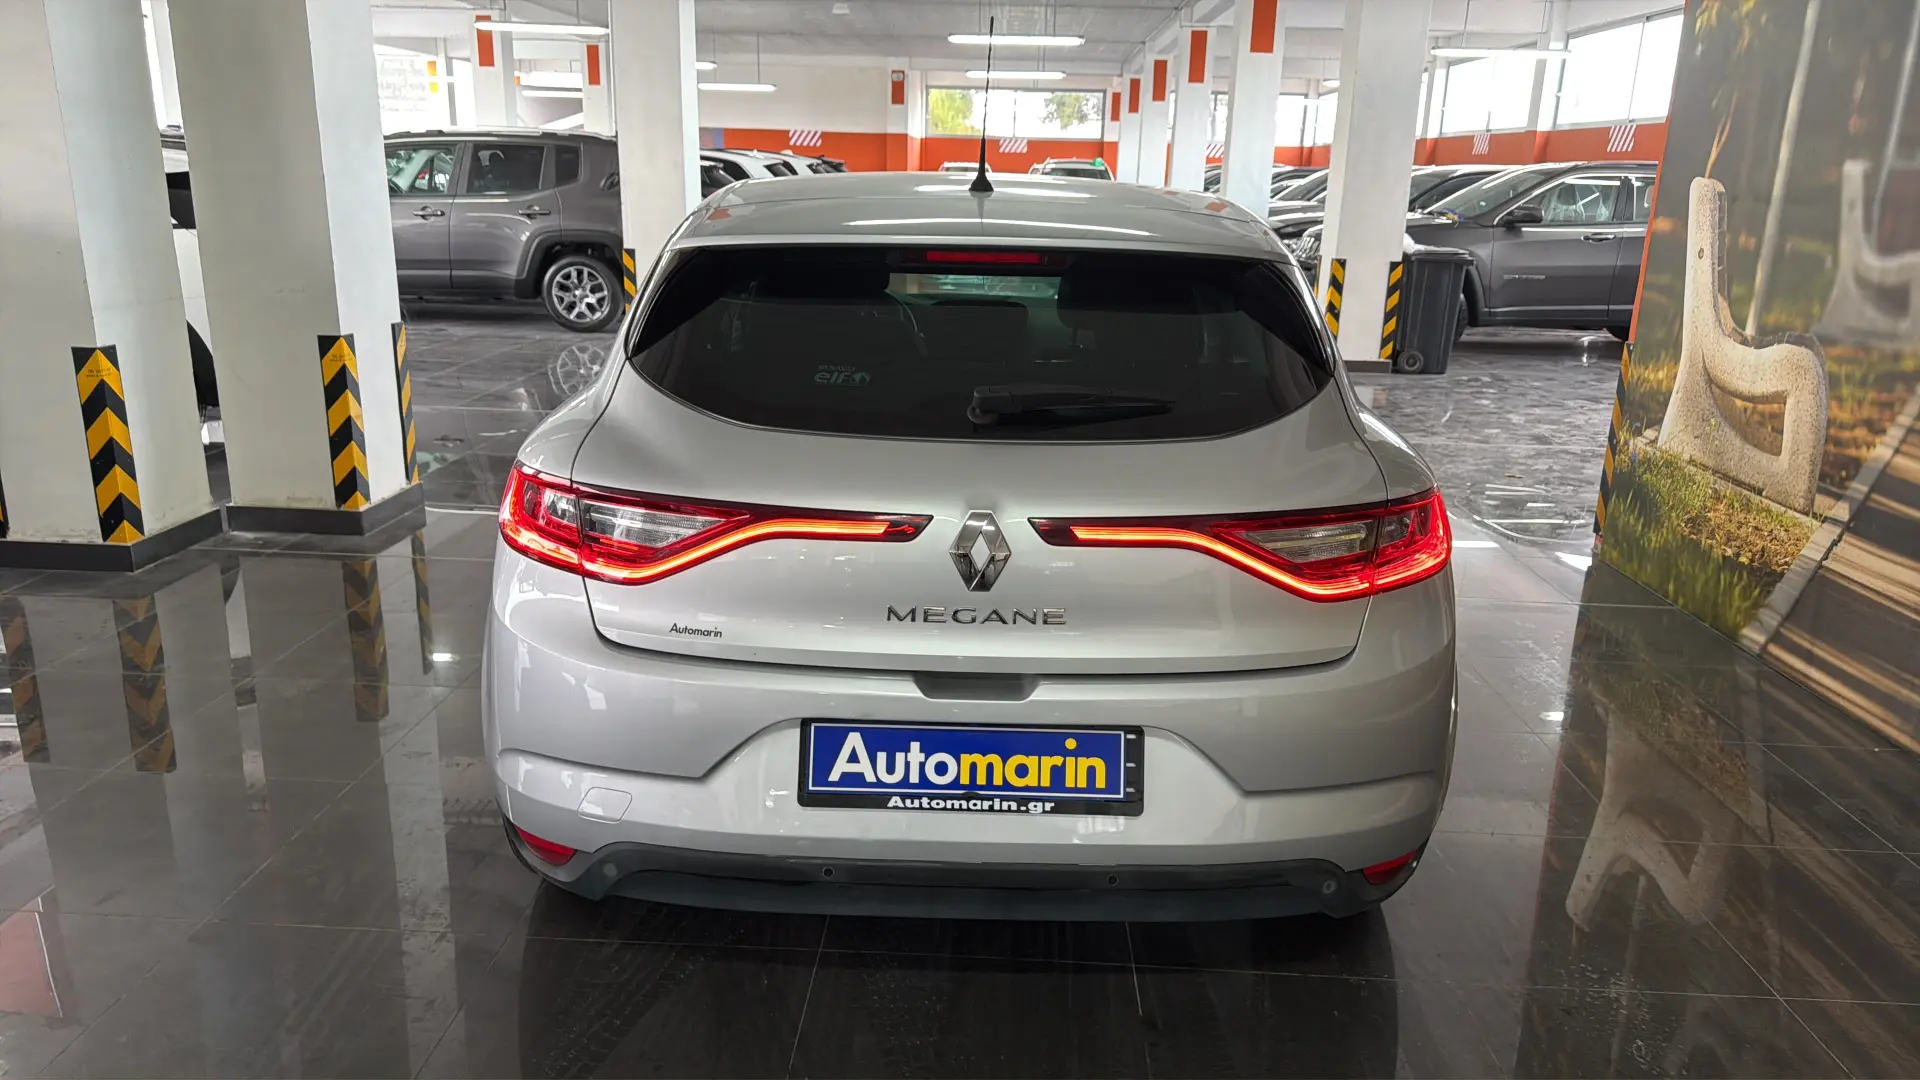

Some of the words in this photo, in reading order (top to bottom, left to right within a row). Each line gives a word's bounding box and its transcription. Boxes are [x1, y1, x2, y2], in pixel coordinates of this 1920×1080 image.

[886, 604, 1067, 625] MEGANE
[669, 622, 723, 639] Automarin
[828, 731, 1106, 789] Automarin
[886, 795, 1055, 814] Automarin.gr
